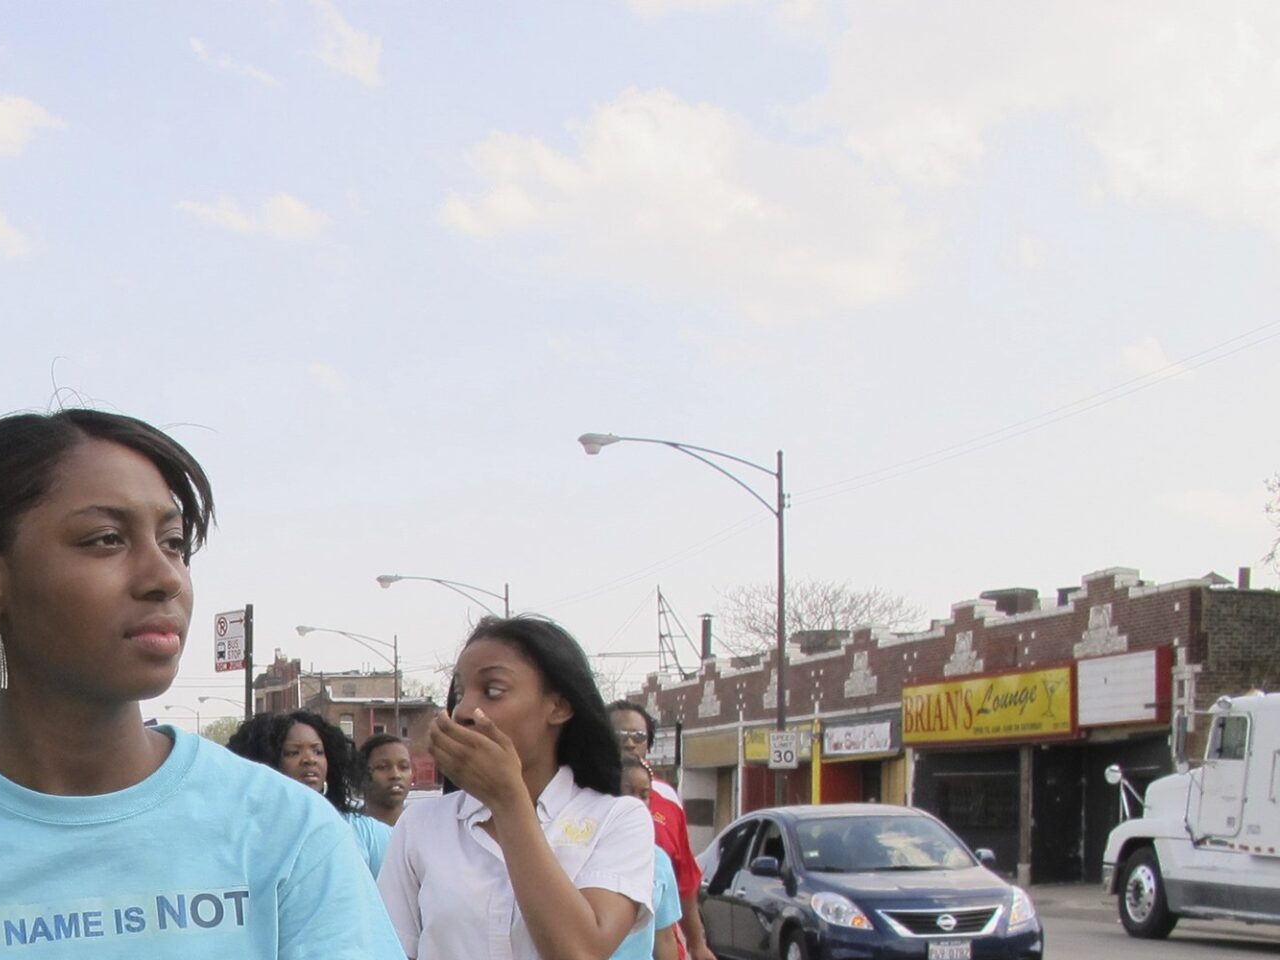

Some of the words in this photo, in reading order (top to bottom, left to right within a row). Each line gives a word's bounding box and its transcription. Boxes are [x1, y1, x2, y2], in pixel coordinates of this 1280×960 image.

[227, 640, 239, 650] BUS
[227, 649, 241, 660] STOP
[904, 687, 974, 734] BRIAN'S
[976, 683, 1038, 715] Lounge
[772, 733, 796, 742] SPEED
[773, 741, 793, 749] LIMIT
[773, 750, 794, 763] 30
[4, 911, 104, 946] NAME
[115, 906, 146, 934] IS
[155, 890, 250, 930] NOT
